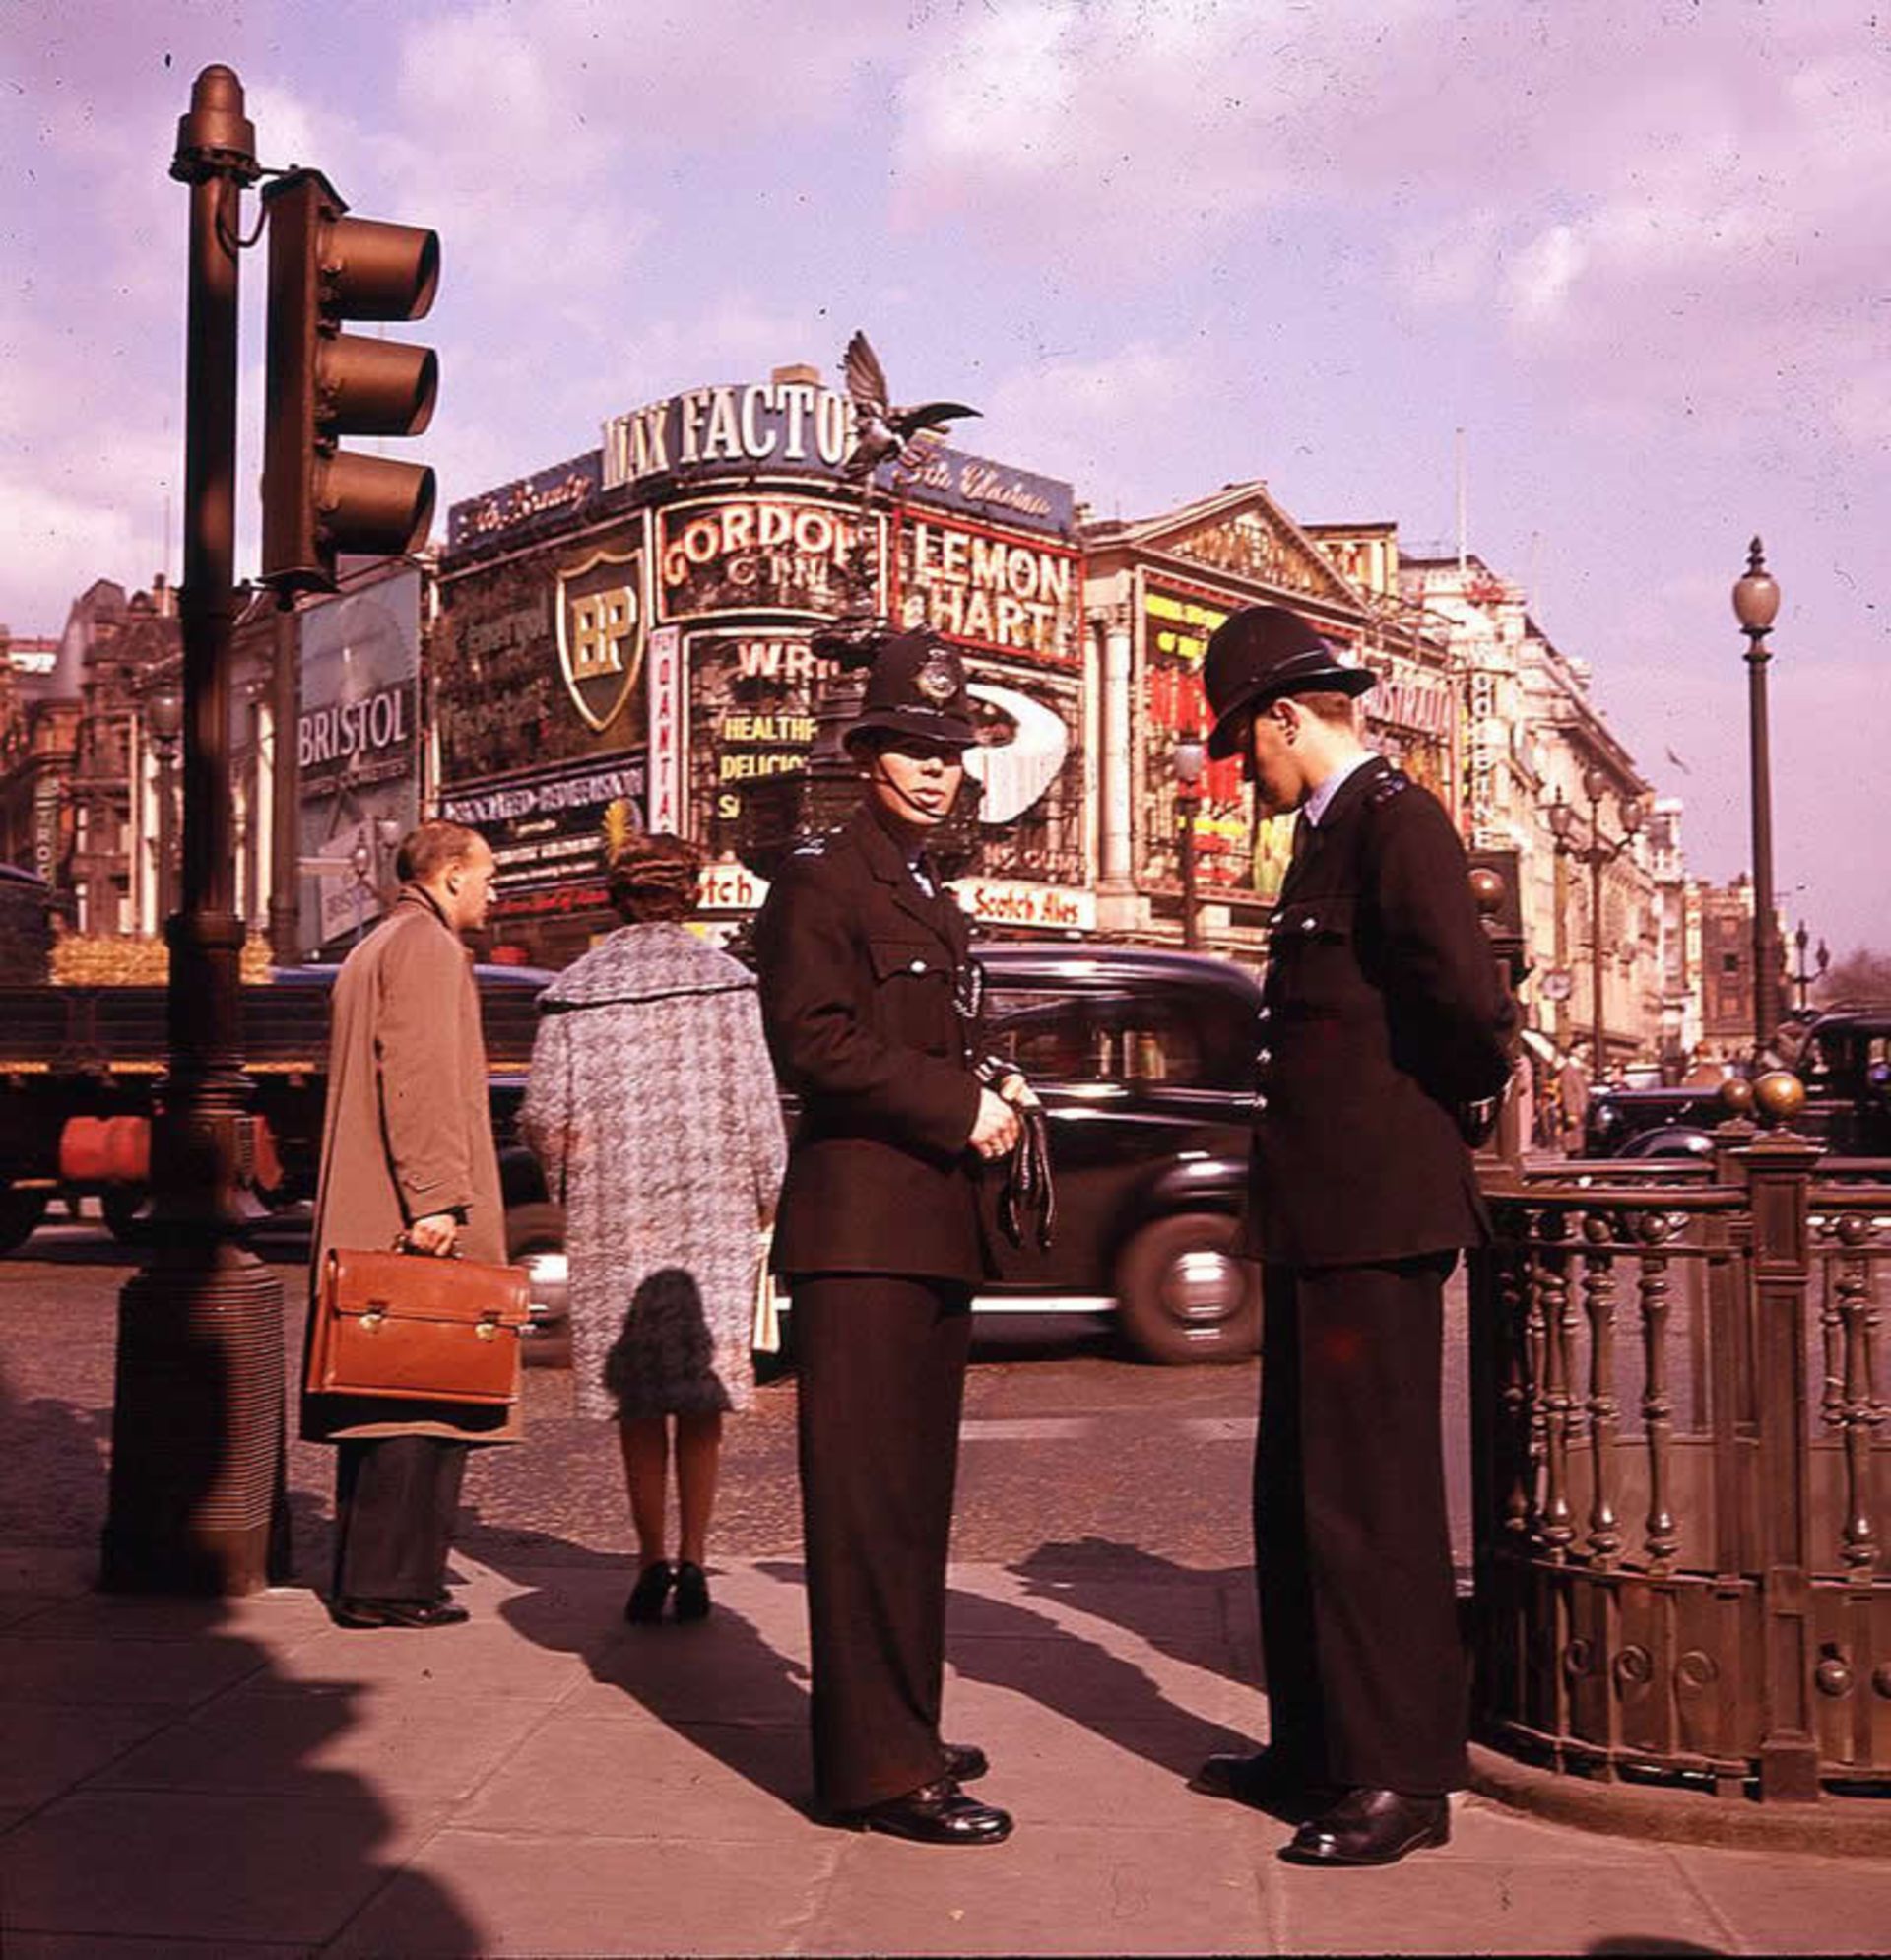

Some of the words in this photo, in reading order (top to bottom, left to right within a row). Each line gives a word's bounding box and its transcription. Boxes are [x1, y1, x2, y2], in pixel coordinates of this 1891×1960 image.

[601, 399, 670, 491] MAX
[914, 522, 1072, 607] LEMON
[571, 585, 638, 681] BP
[931, 583, 1057, 652] HART
[298, 689, 409, 767] BRISTOL
[723, 715, 820, 742] HEALTHF
[694, 873, 753, 904] tch
[974, 887, 1036, 921] Scotch
